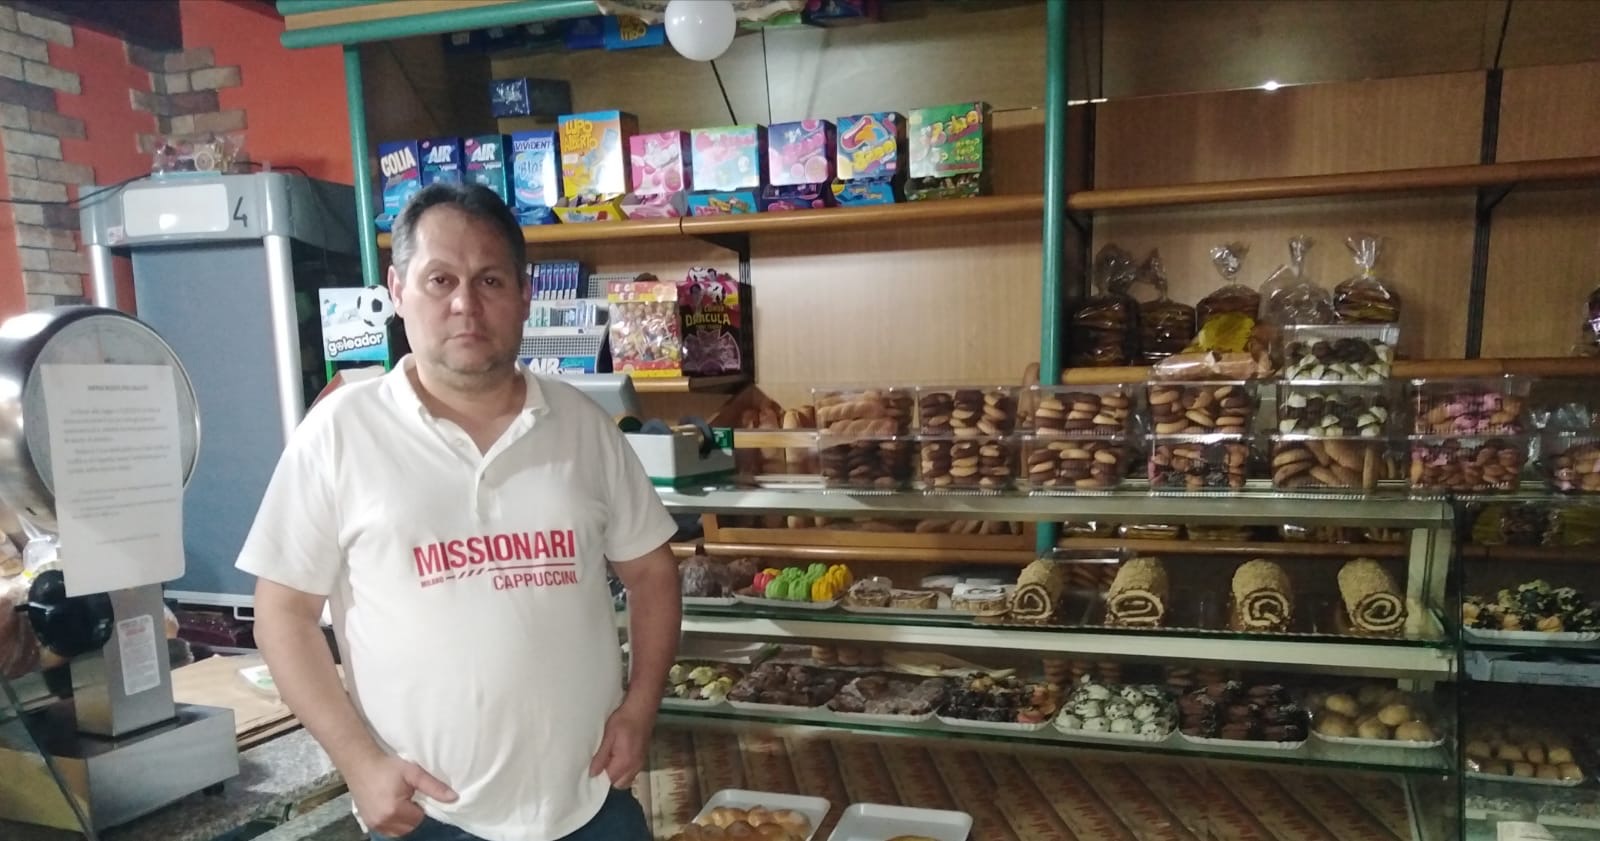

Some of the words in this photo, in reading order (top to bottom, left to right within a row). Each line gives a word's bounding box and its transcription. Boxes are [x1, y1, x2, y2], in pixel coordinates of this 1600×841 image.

[565, 121, 593, 135] LUPO
[428, 145, 453, 164] AIR
[471, 143, 497, 162] AIR
[233, 196, 248, 228] 4
[328, 332, 384, 357] goleador
[528, 357, 561, 374] AIR
[413, 529, 576, 577] MISSIONARI
[493, 570, 578, 591] CAPPUCCINI
